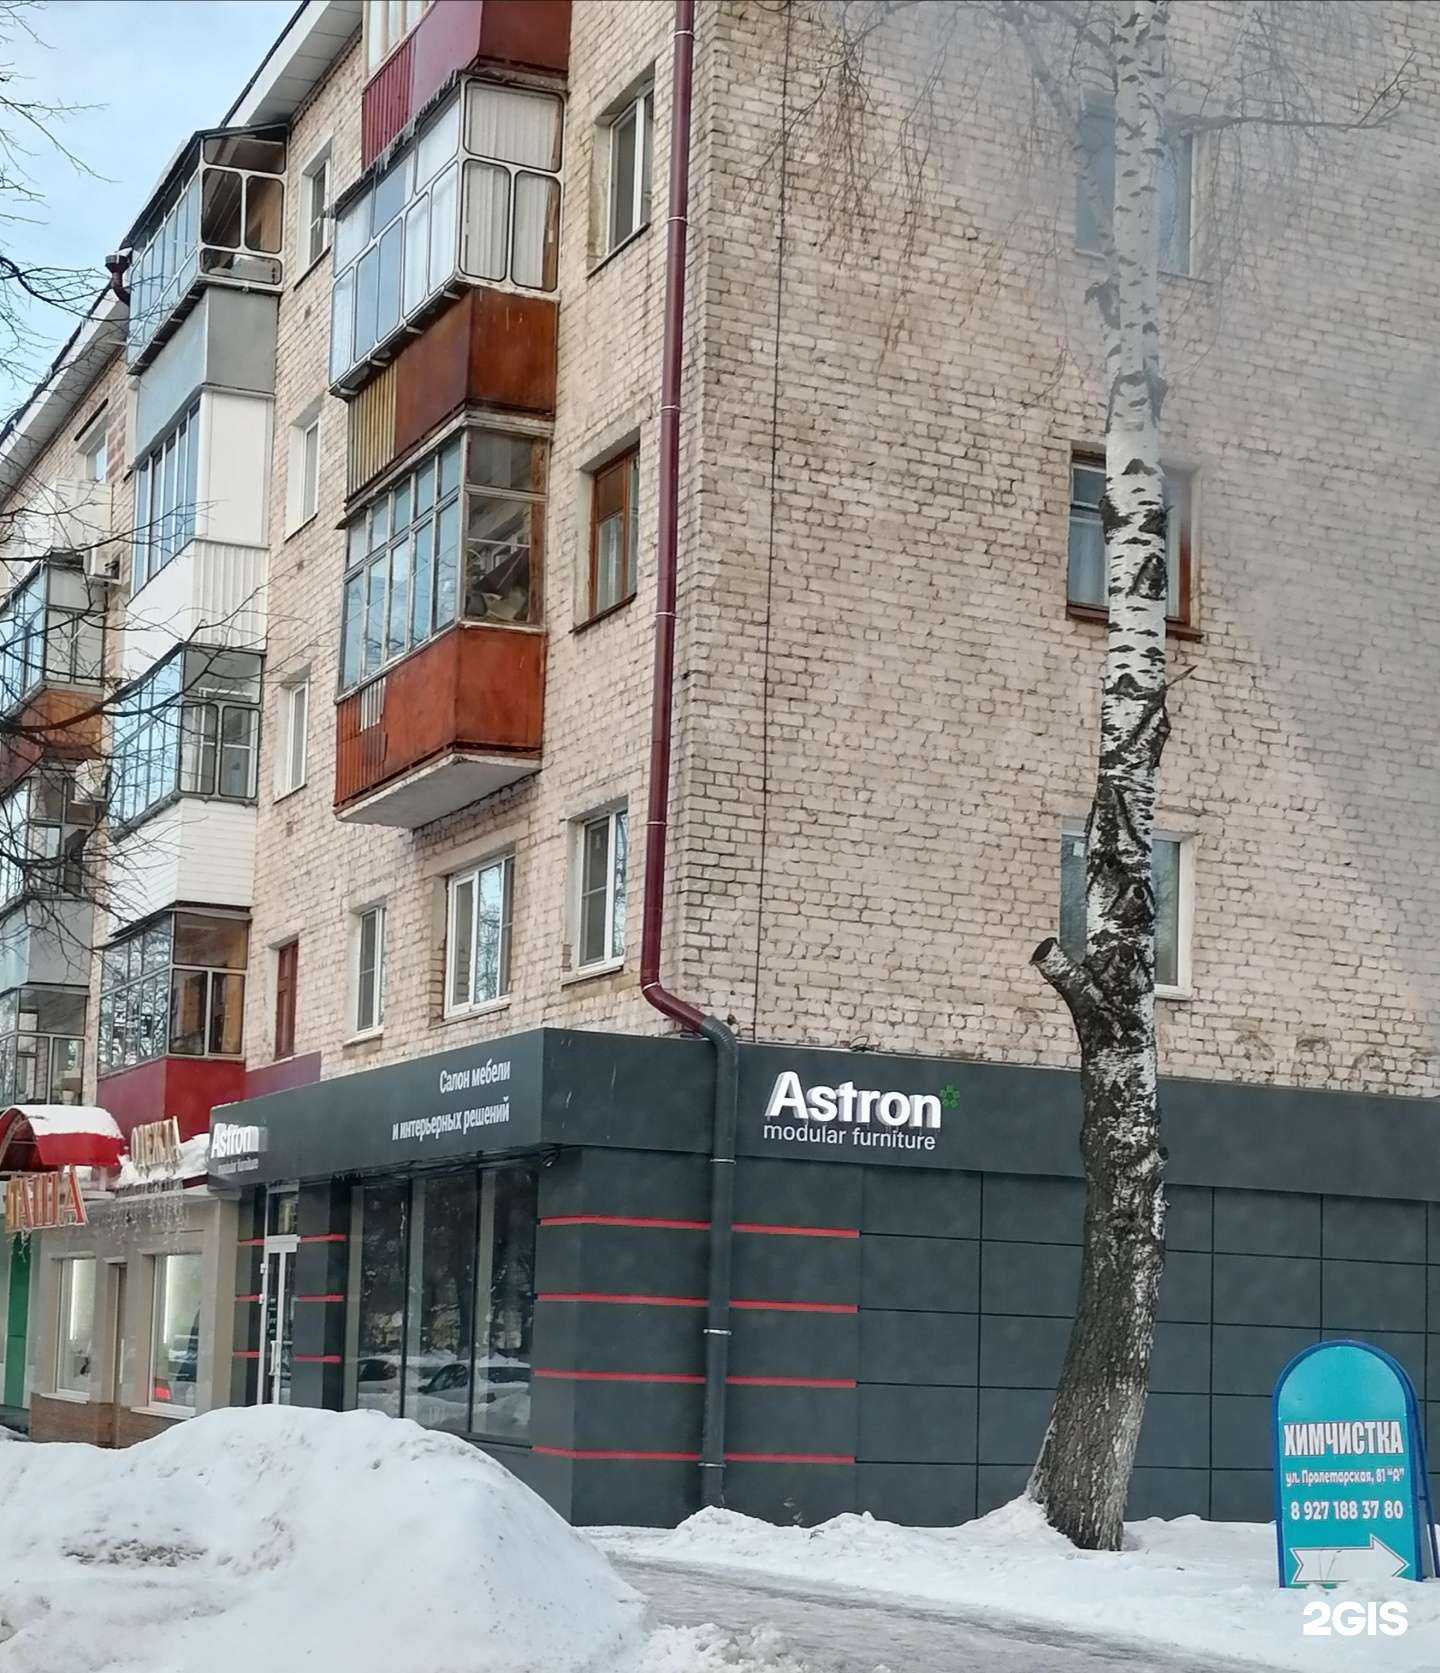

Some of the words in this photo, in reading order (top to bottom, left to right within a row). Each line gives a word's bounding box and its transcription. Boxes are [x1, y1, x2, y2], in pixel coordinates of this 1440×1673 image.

[440, 1070, 470, 1093] Салон
[471, 1058, 511, 1087] мебели
[765, 1071, 942, 1129] Astron
[392, 1122, 399, 1141] и
[399, 1111, 462, 1142] интерьерных
[463, 1096, 510, 1135] решений
[763, 1123, 846, 1145] modular
[852, 1127, 936, 1150] furniture
[210, 1122, 260, 1159] Astron
[1284, 1421, 1404, 1456] ХИМЧИСТКА
[1286, 1471, 1300, 1487] ул.
[1301, 1469, 1374, 1487] Пролетарская,
[1291, 1501, 1300, 1520] 8
[1304, 1501, 1329, 1520] 927
[1333, 1501, 1358, 1520] 188
[1362, 1500, 1379, 1519] 37
[1384, 1500, 1404, 1519] 80
